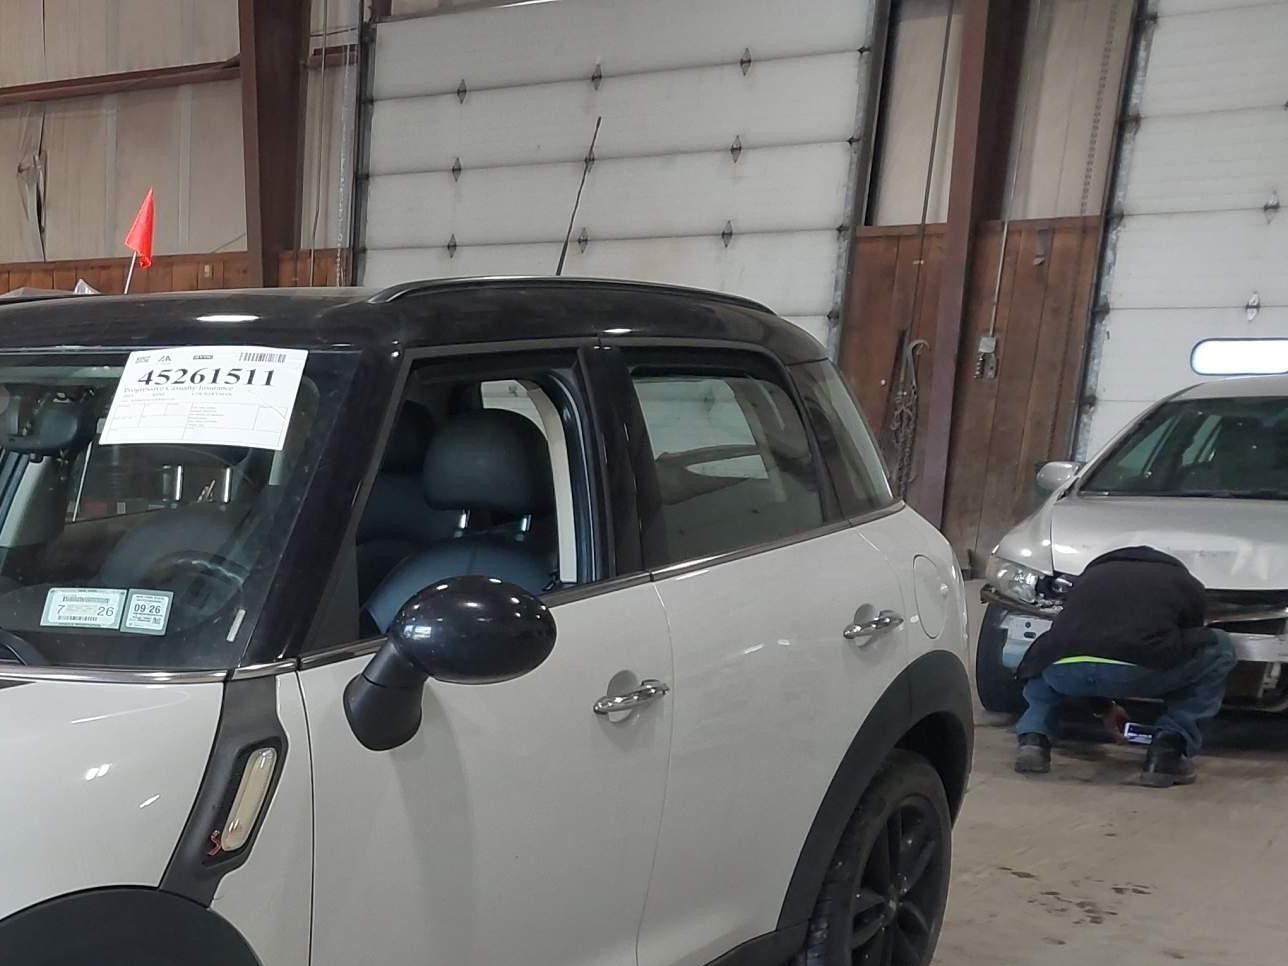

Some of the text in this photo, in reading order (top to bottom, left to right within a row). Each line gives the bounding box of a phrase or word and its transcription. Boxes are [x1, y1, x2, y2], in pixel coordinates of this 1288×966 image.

[138, 367, 275, 387] 45261511
[57, 604, 114, 617] 7 26
